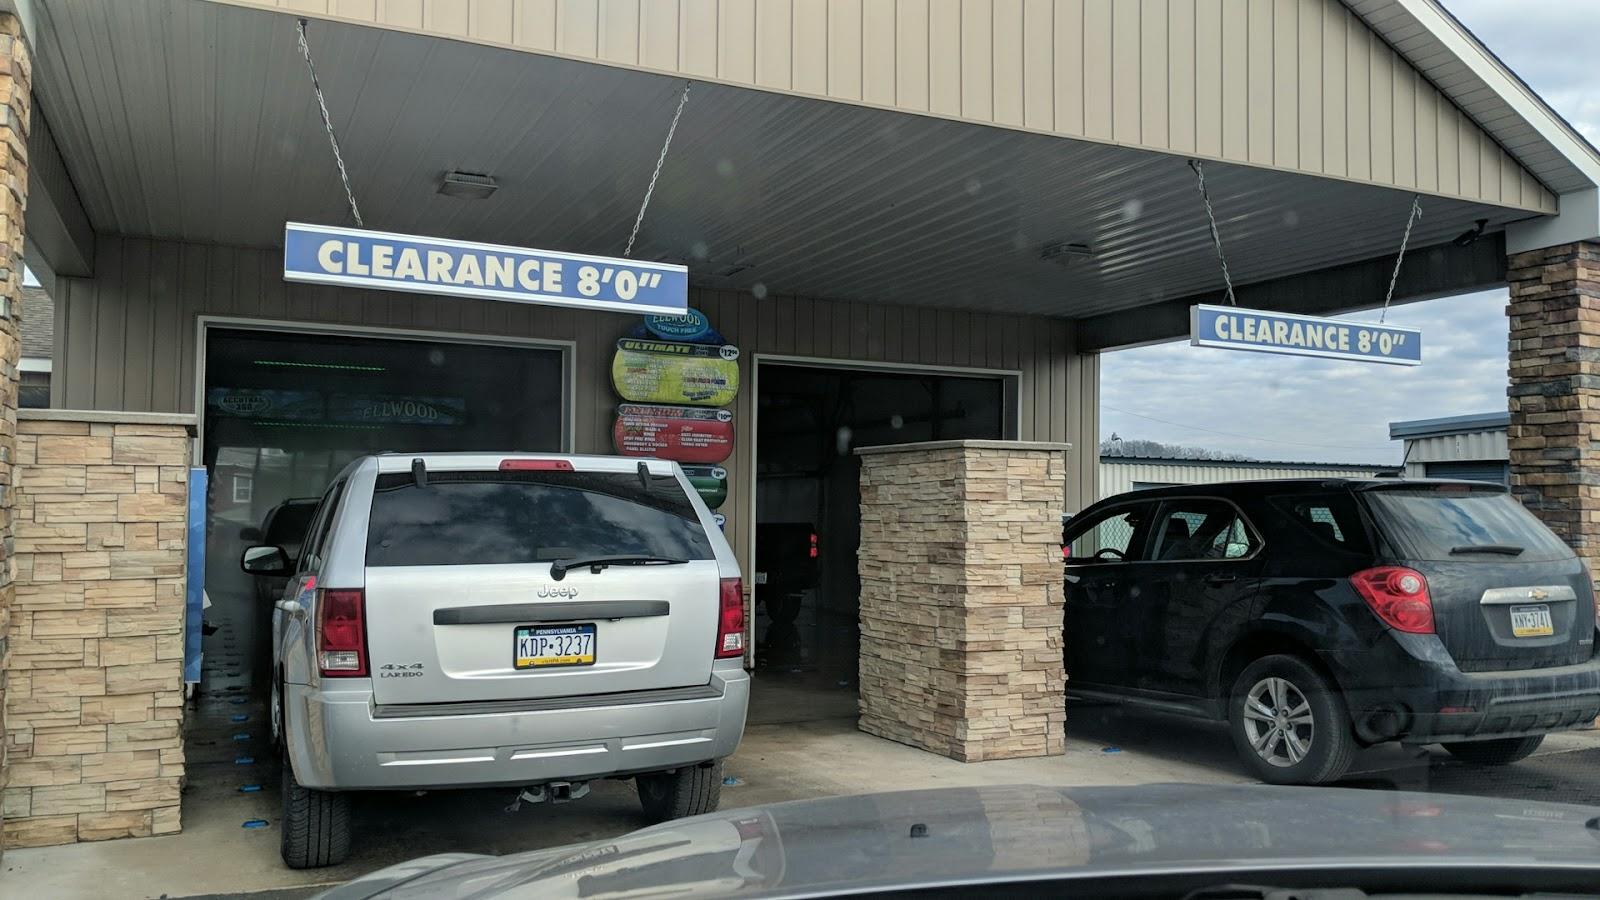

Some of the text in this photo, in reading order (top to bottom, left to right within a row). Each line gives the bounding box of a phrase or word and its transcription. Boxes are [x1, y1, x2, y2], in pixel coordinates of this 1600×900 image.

[318, 240, 562, 293] CLEARANCE
[657, 324, 679, 334] TOUCH
[1215, 314, 1349, 351] CLEARANCE
[624, 341, 691, 354] ULTIMATE
[363, 400, 439, 420] ELLWOOD
[537, 584, 578, 599] Jeep
[536, 627, 577, 635] PENNSYLVANIA
[380, 663, 424, 671] 4x4
